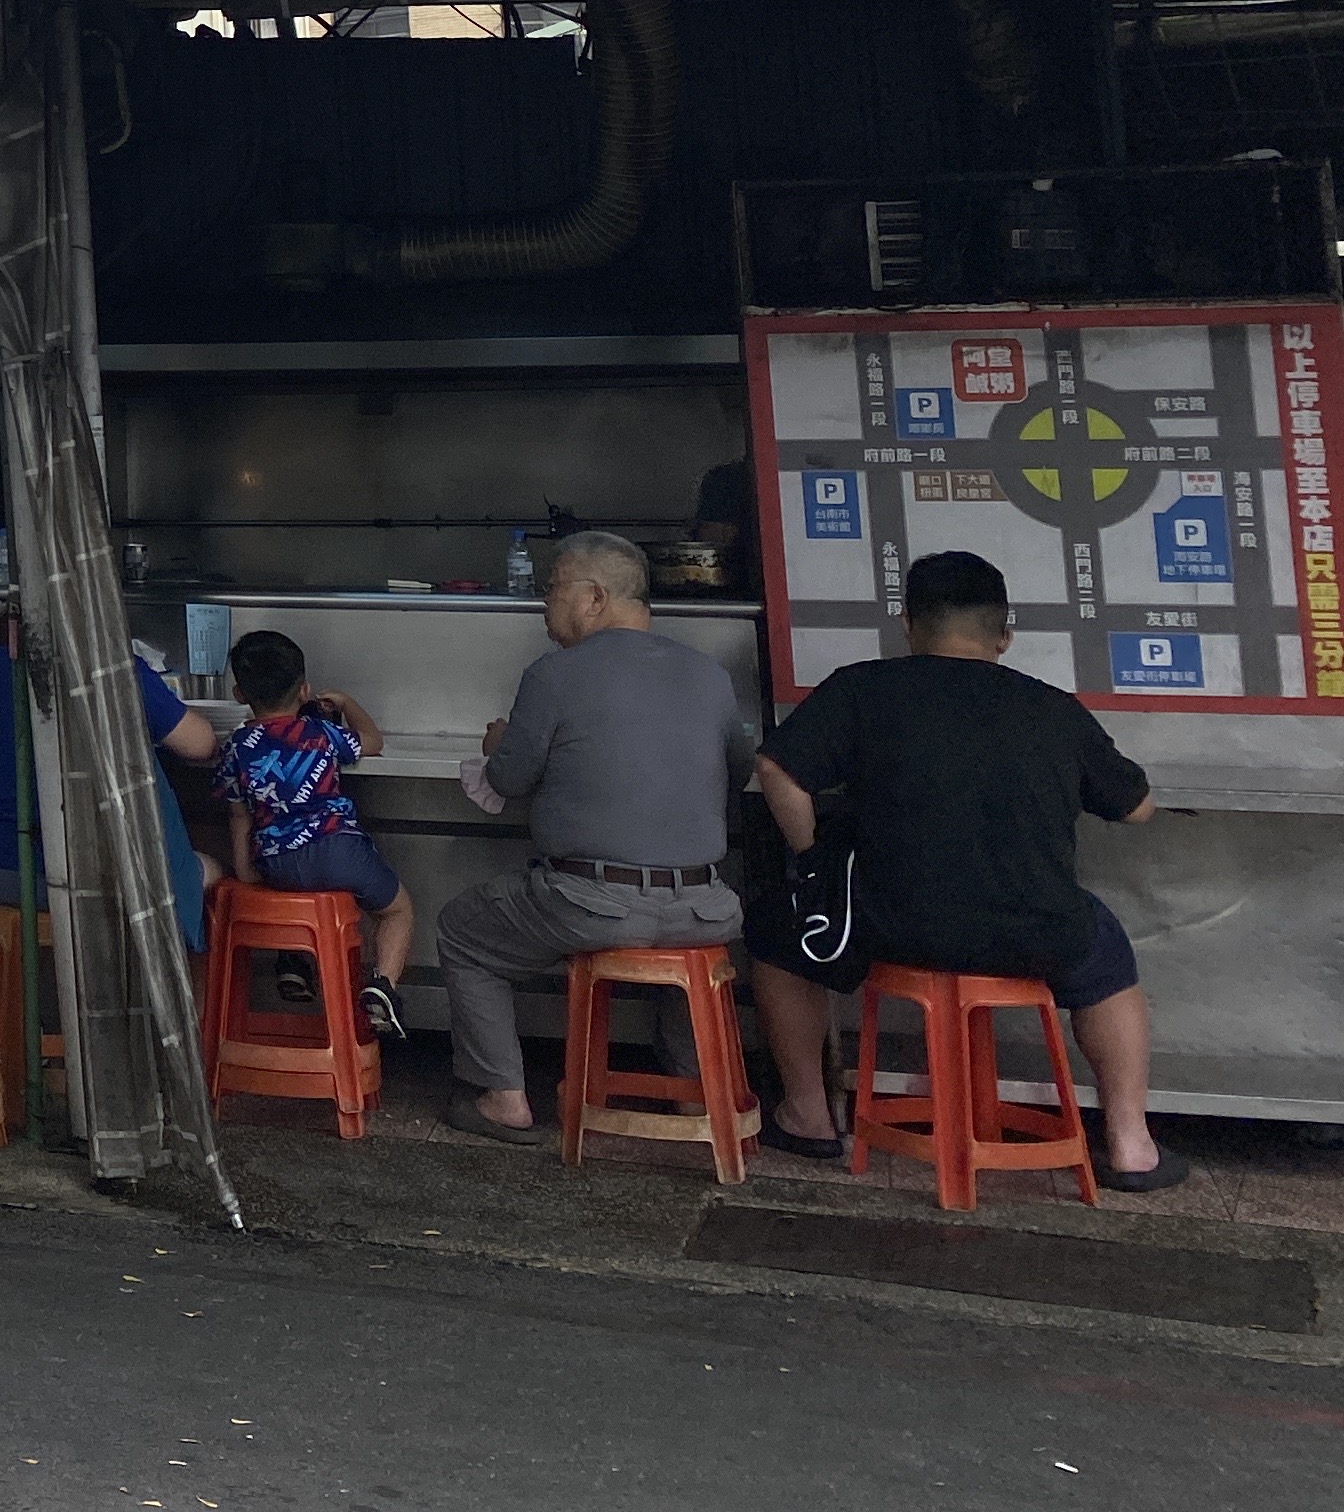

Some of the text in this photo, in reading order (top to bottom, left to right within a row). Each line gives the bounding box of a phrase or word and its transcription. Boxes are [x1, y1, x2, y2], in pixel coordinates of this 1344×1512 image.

[918, 397, 932, 413] P
[864, 448, 946, 463] 府前路一段
[1124, 446, 1212, 462] 府前路二段
[824, 483, 838, 499] P
[1184, 525, 1198, 541] P
[1149, 644, 1163, 660] P
[242, 723, 266, 749] WHY
[310, 758, 328, 783] AND
